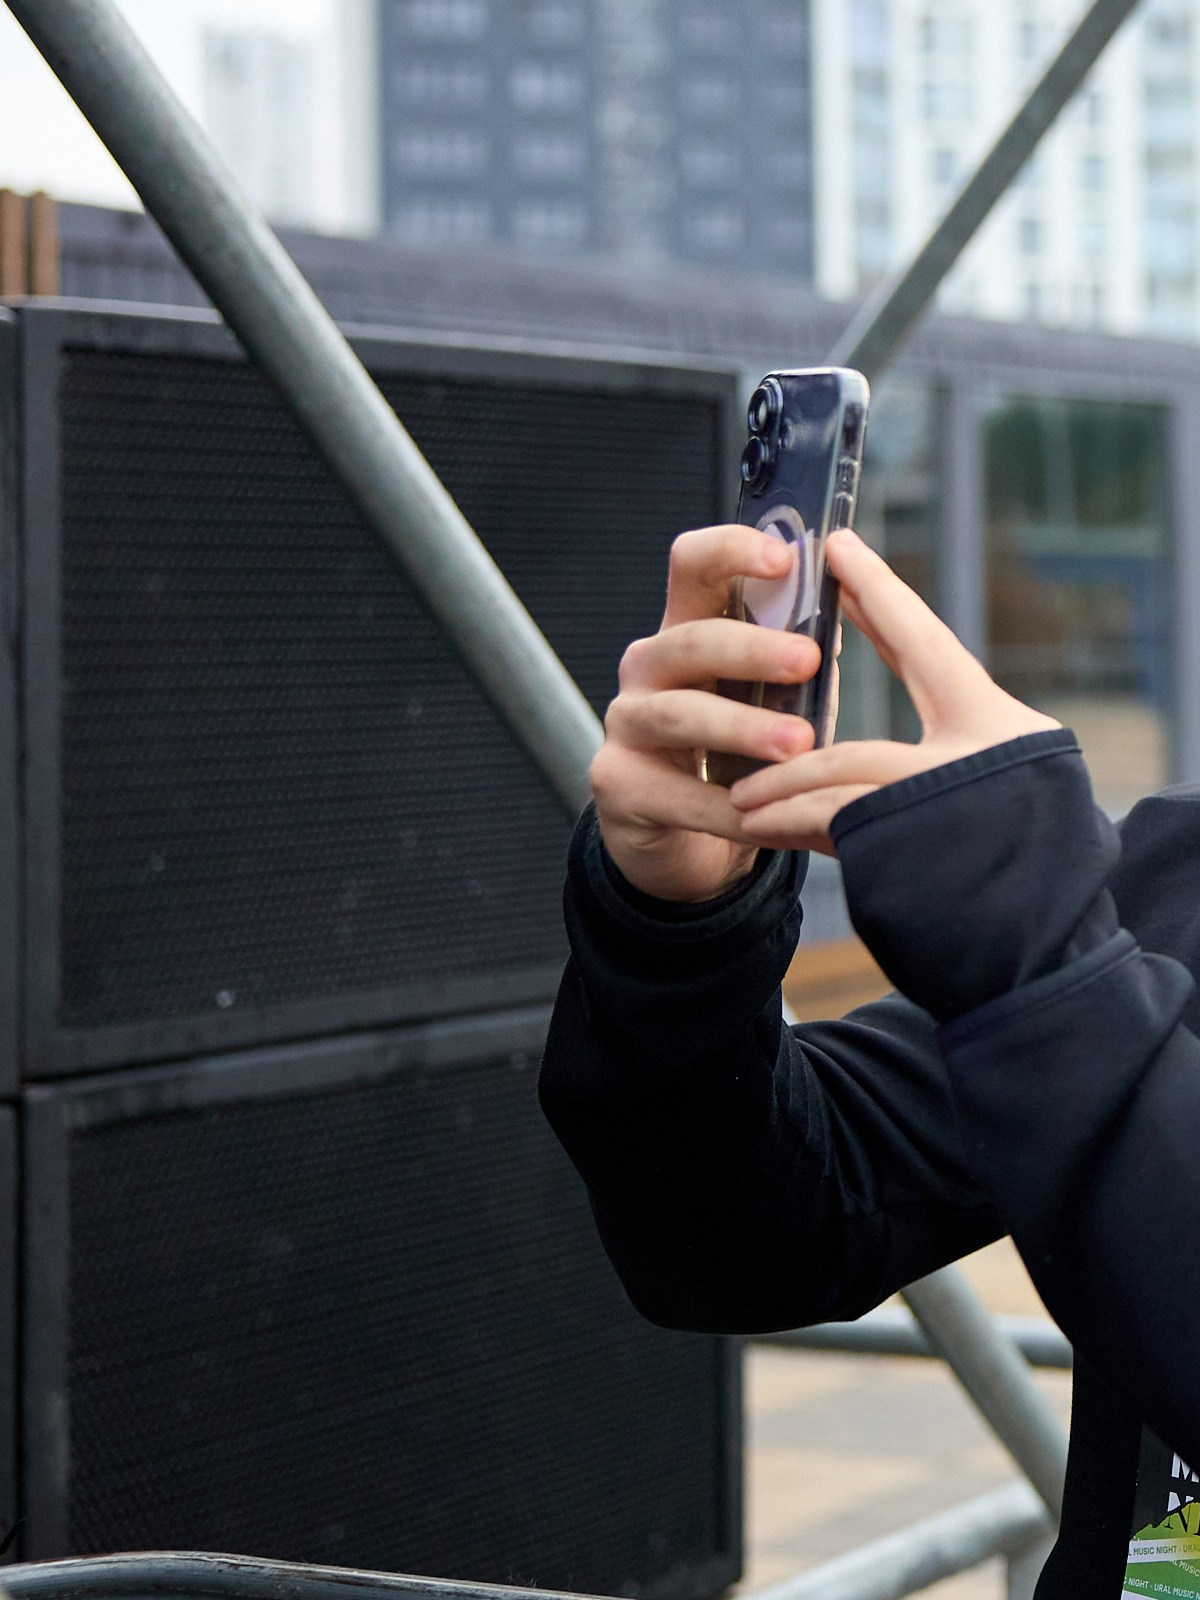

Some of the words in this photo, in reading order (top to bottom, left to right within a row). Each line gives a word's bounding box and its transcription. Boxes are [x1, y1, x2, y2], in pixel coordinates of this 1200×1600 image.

[1133, 1546, 1155, 1556] MUSIC
[1155, 1545, 1178, 1555] NIGHT
[1178, 1560, 1200, 1577] MUSIC
[1127, 1577, 1149, 1589] NIGHT
[1153, 1583, 1172, 1594] URAL
[1172, 1587, 1195, 1599] MUSIC
